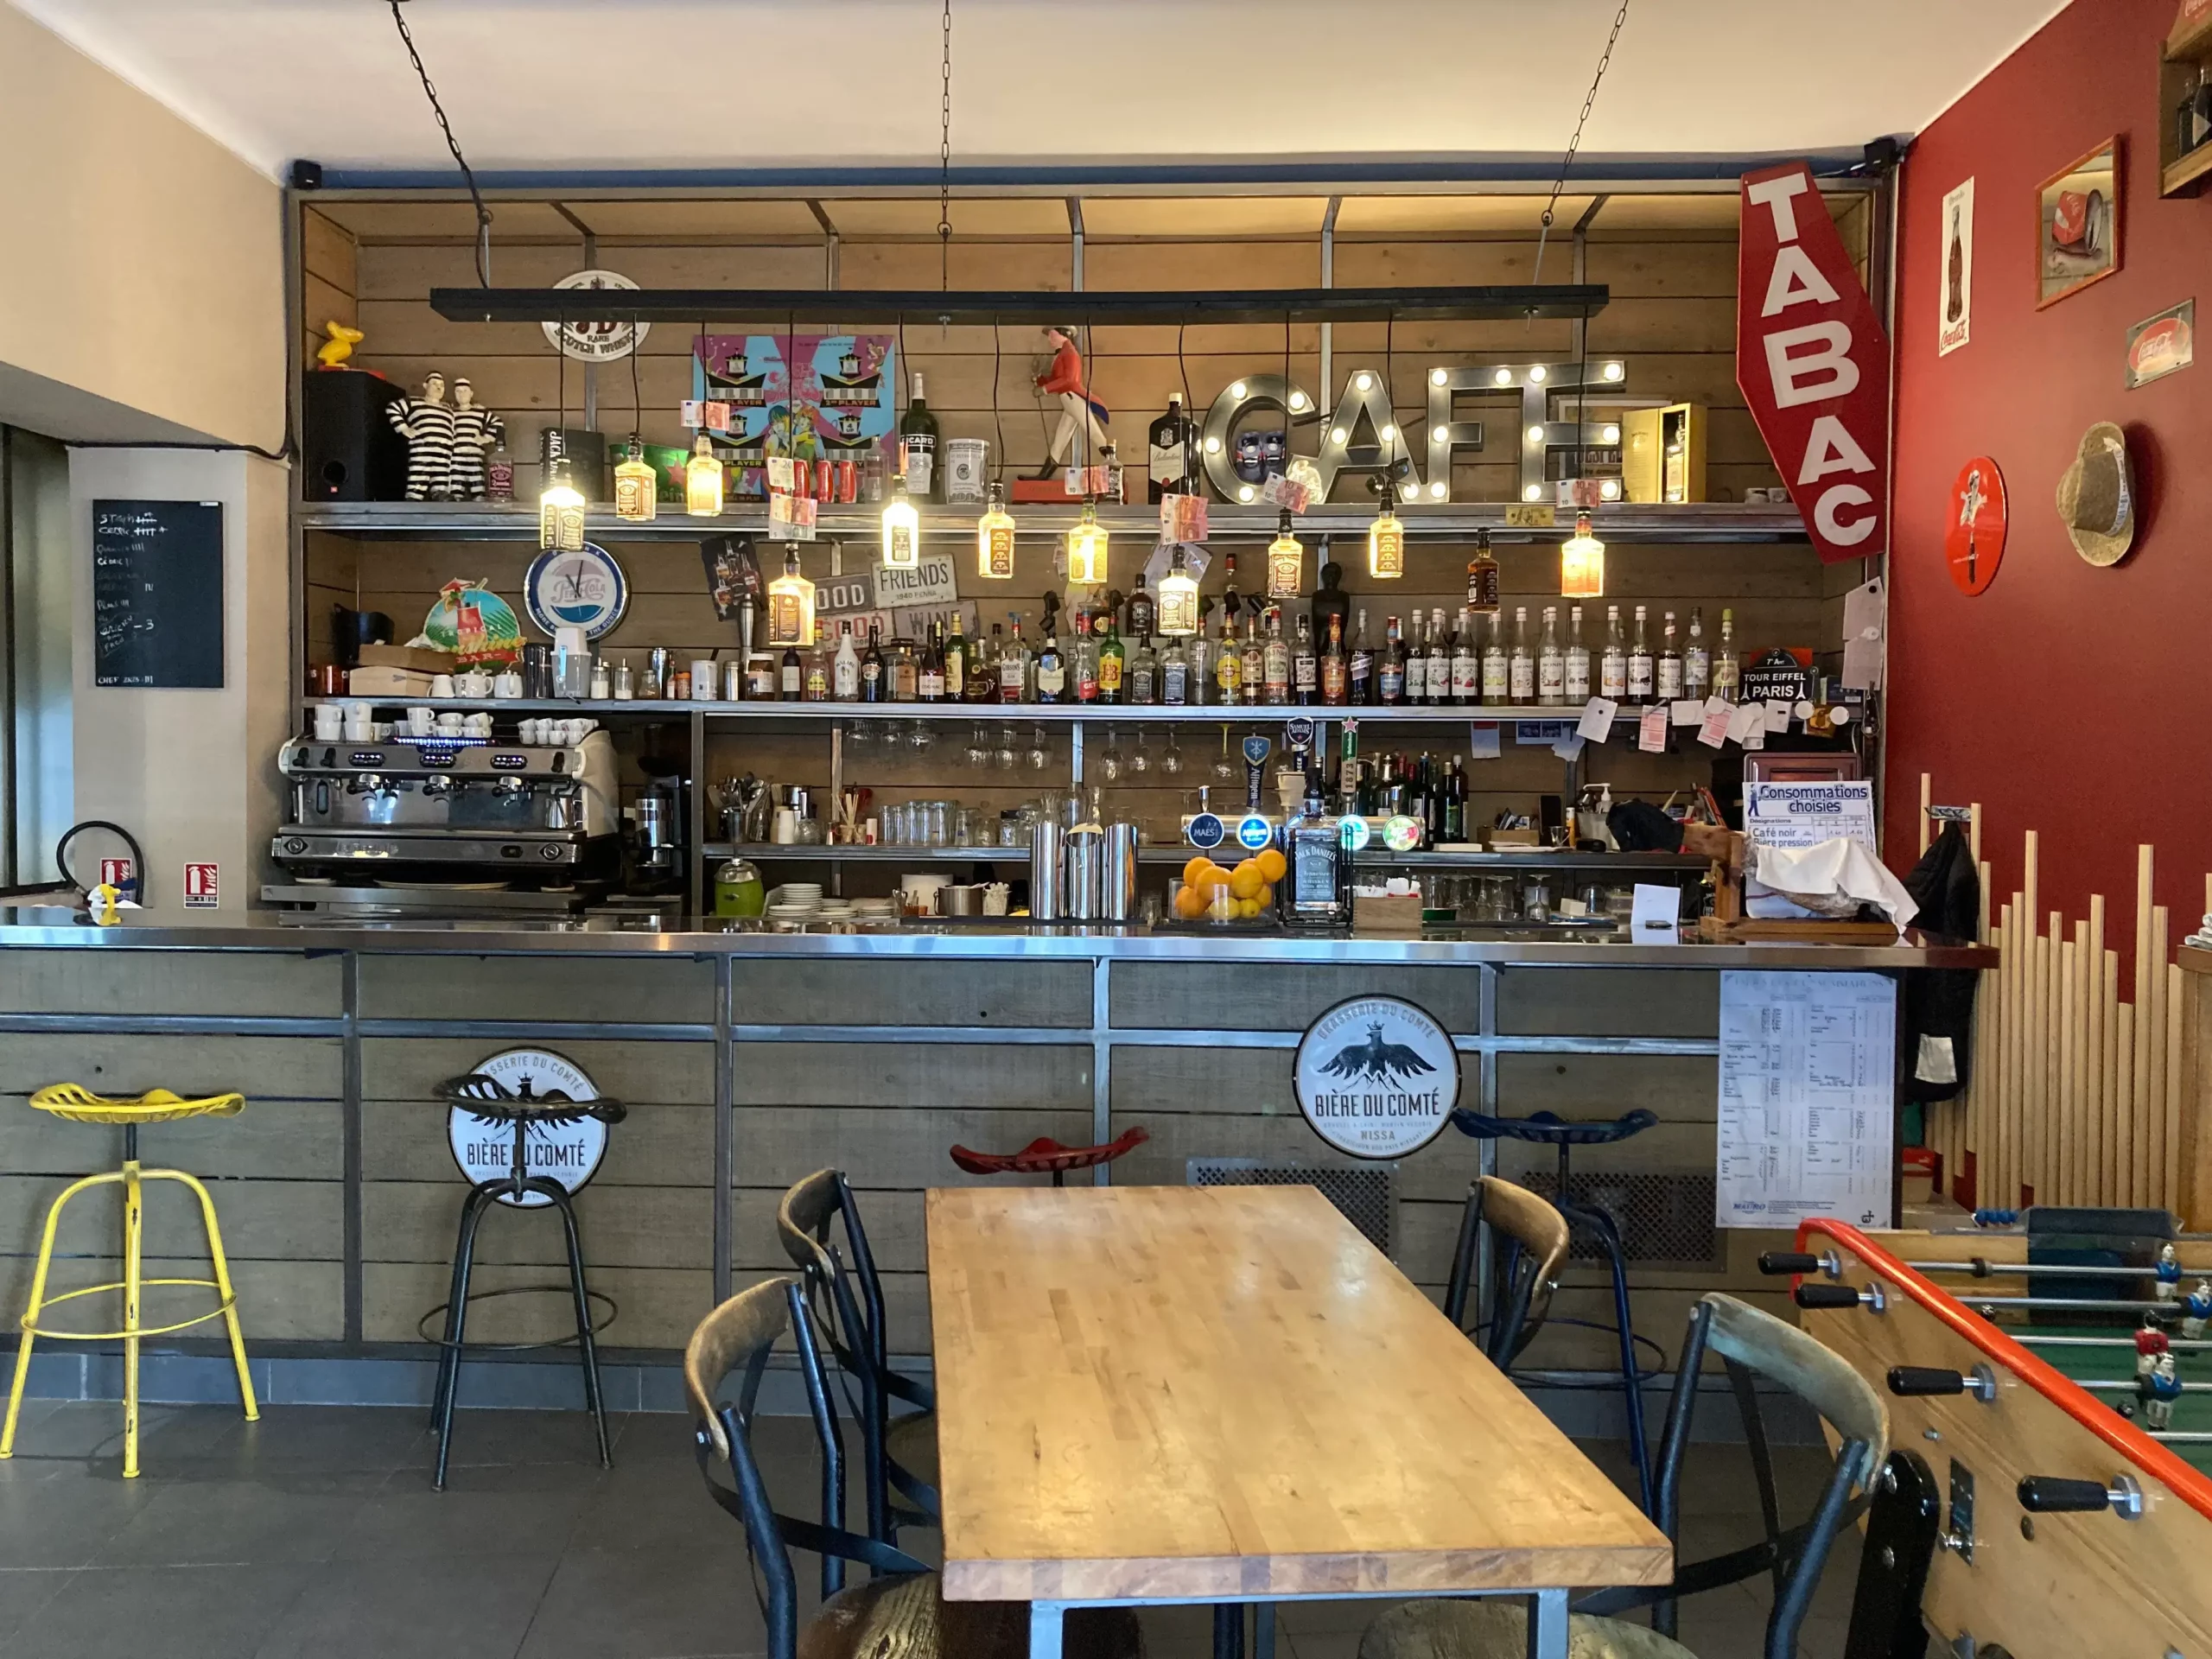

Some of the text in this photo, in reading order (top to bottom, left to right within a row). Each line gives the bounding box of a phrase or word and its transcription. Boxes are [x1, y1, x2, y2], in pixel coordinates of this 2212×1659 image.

[1747, 172, 1876, 546] TABAC
[550, 431, 562, 460] JACK
[1285, 480, 1294, 489] 10
[1576, 480, 1585, 489] 10
[880, 563, 949, 591] FRIENDS
[816, 584, 864, 610] OOD
[536, 608, 550, 626] MORE
[589, 608, 620, 635] THE OUNCE
[442, 624, 502, 638] TROPICAL
[1772, 672, 1806, 681] EIFFEL
[1752, 685, 1794, 697] PARIS
[1759, 785, 1868, 799] Consommations
[1789, 799, 1840, 812] choisies
[1752, 828, 1777, 837] Café
[1778, 828, 1796, 837] noir
[1778, 838, 1813, 849] pression
[1294, 846, 1337, 861] JACK DANIEL'S
[1317, 1002, 1437, 1039] BRASSERIE DU COMTÉ
[484, 1056, 585, 1091] ASSERIE DU COMTÉ
[1315, 1087, 1440, 1116] BIÈRE DU COMTÉ
[1360, 1130, 1395, 1141] NISSA
[467, 1137, 508, 1166] BIÈRE
[535, 1138, 586, 1166] COMTÉ
